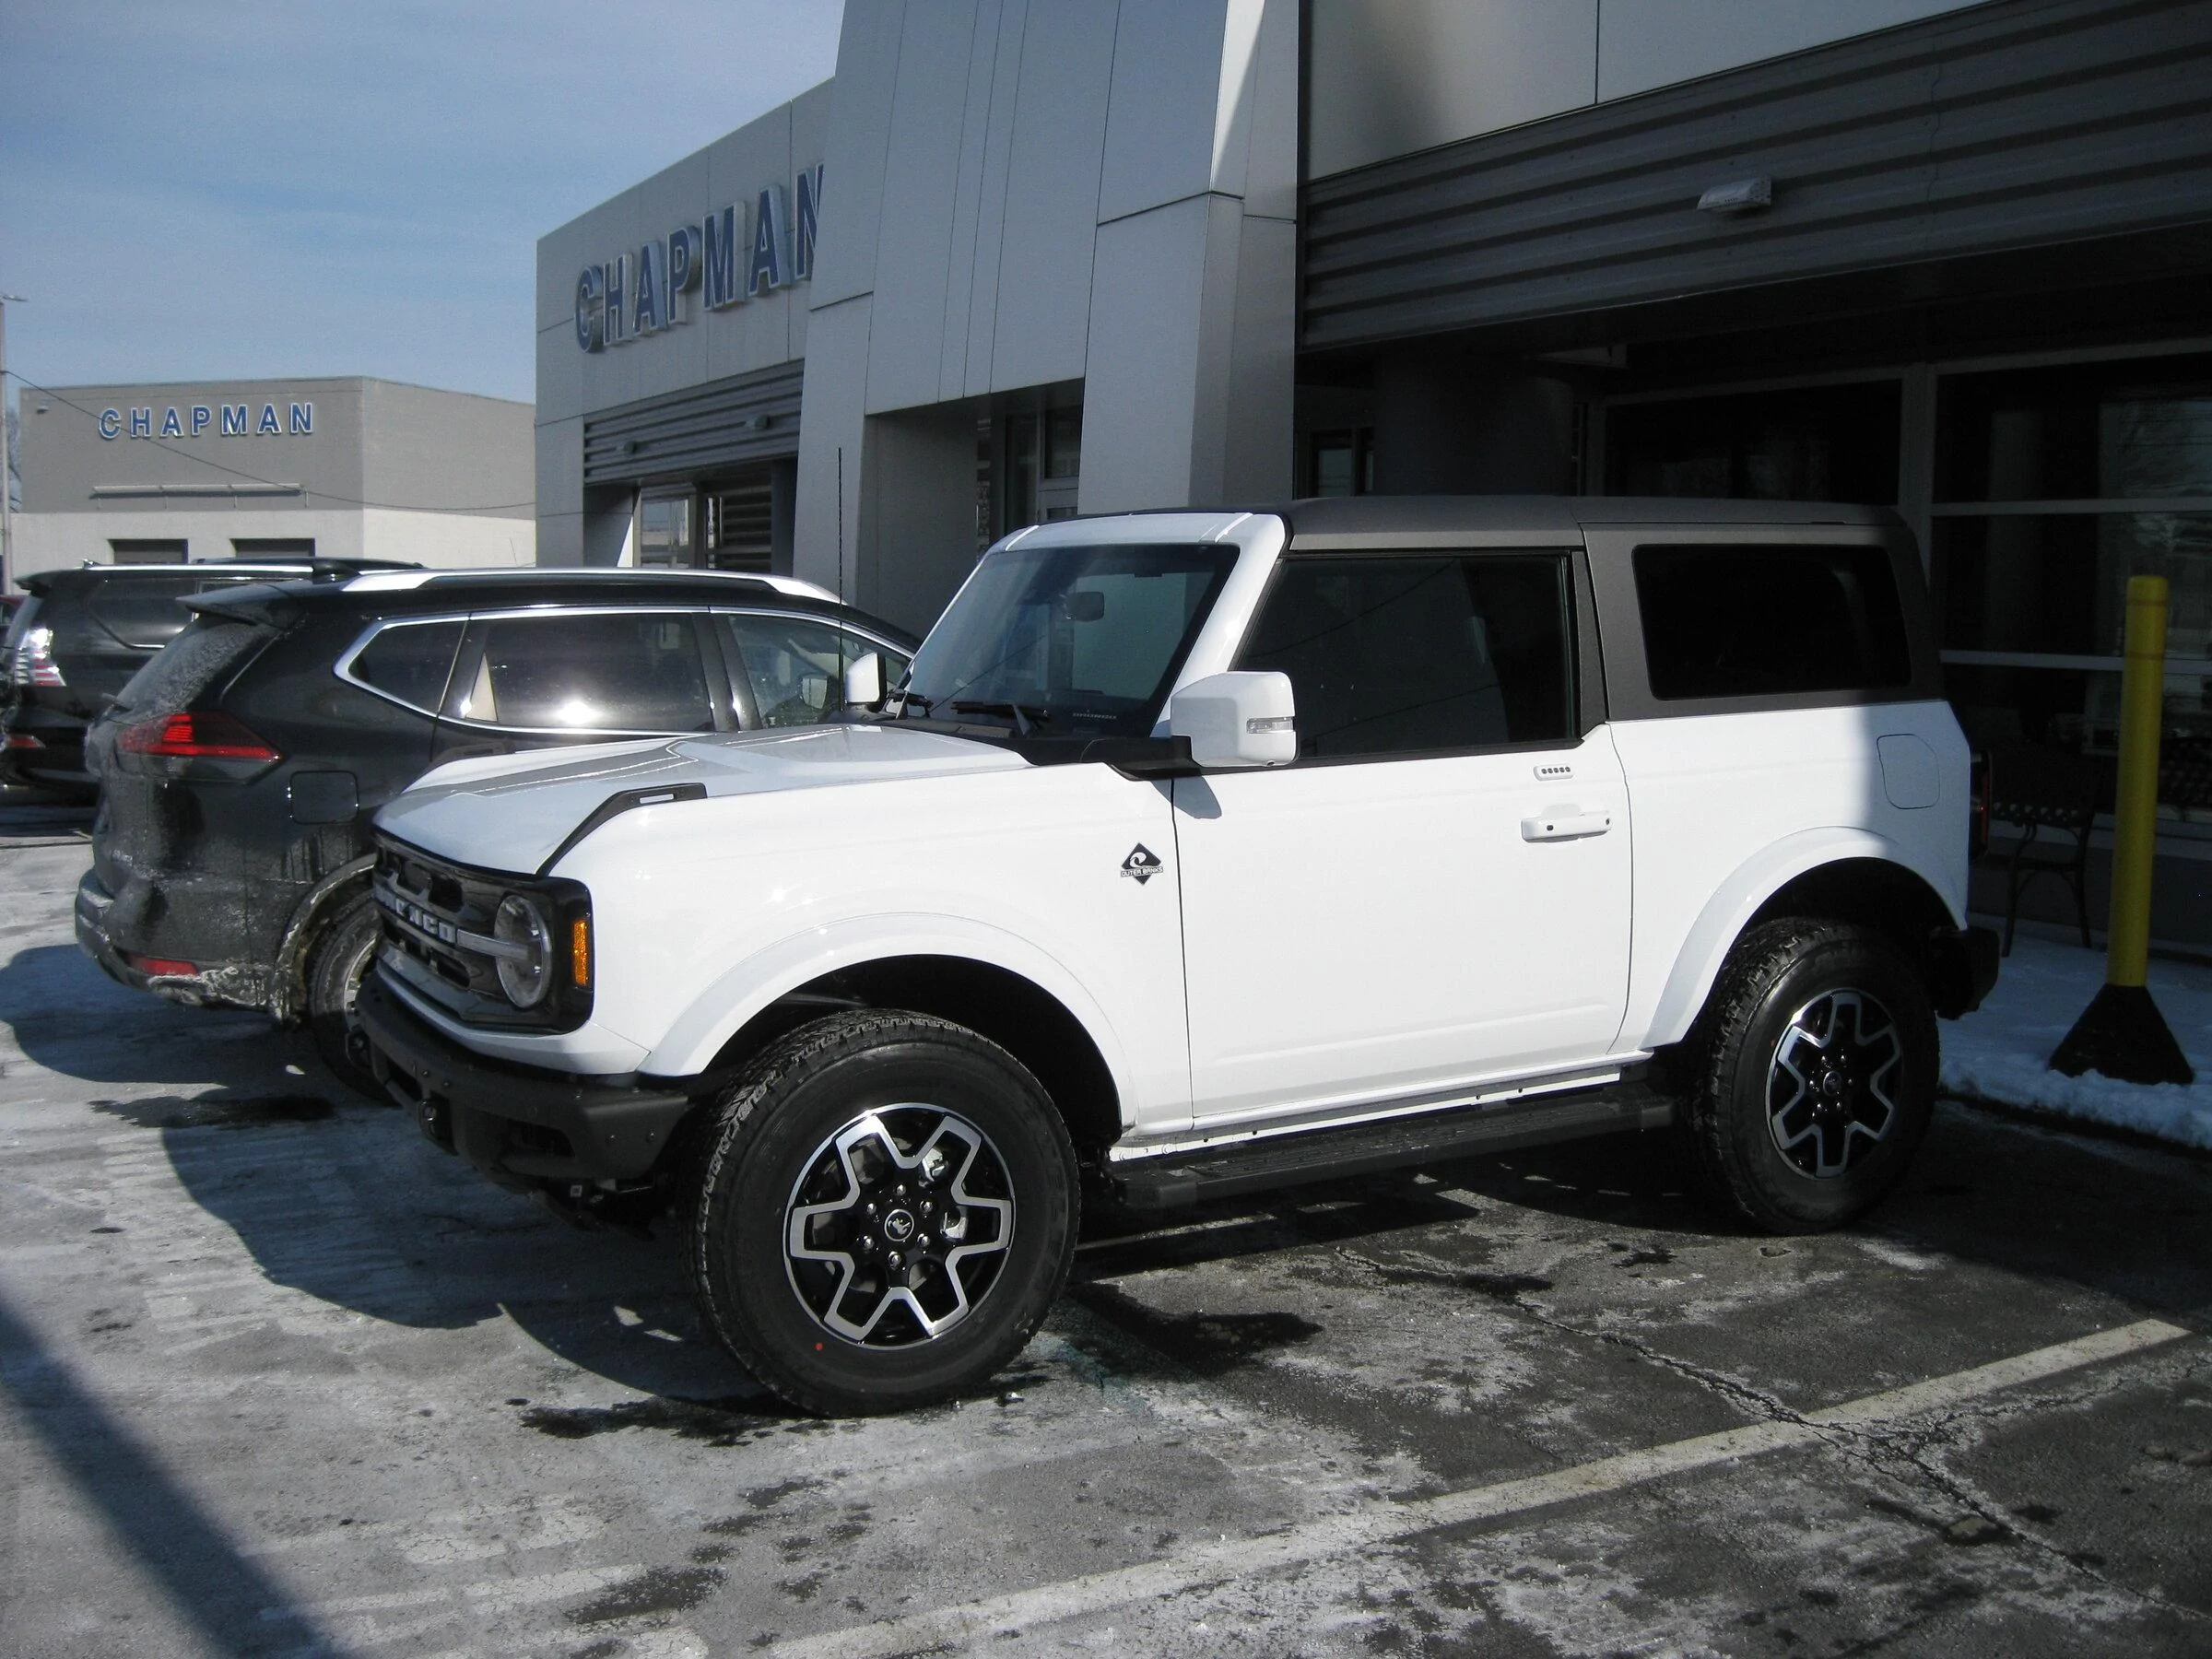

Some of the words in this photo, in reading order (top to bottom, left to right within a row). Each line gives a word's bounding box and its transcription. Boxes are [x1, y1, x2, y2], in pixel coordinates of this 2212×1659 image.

[576, 163, 823, 352] CHAPMAN
[100, 403, 313, 440] CHAPMAN
[374, 882, 456, 943] ONCO
